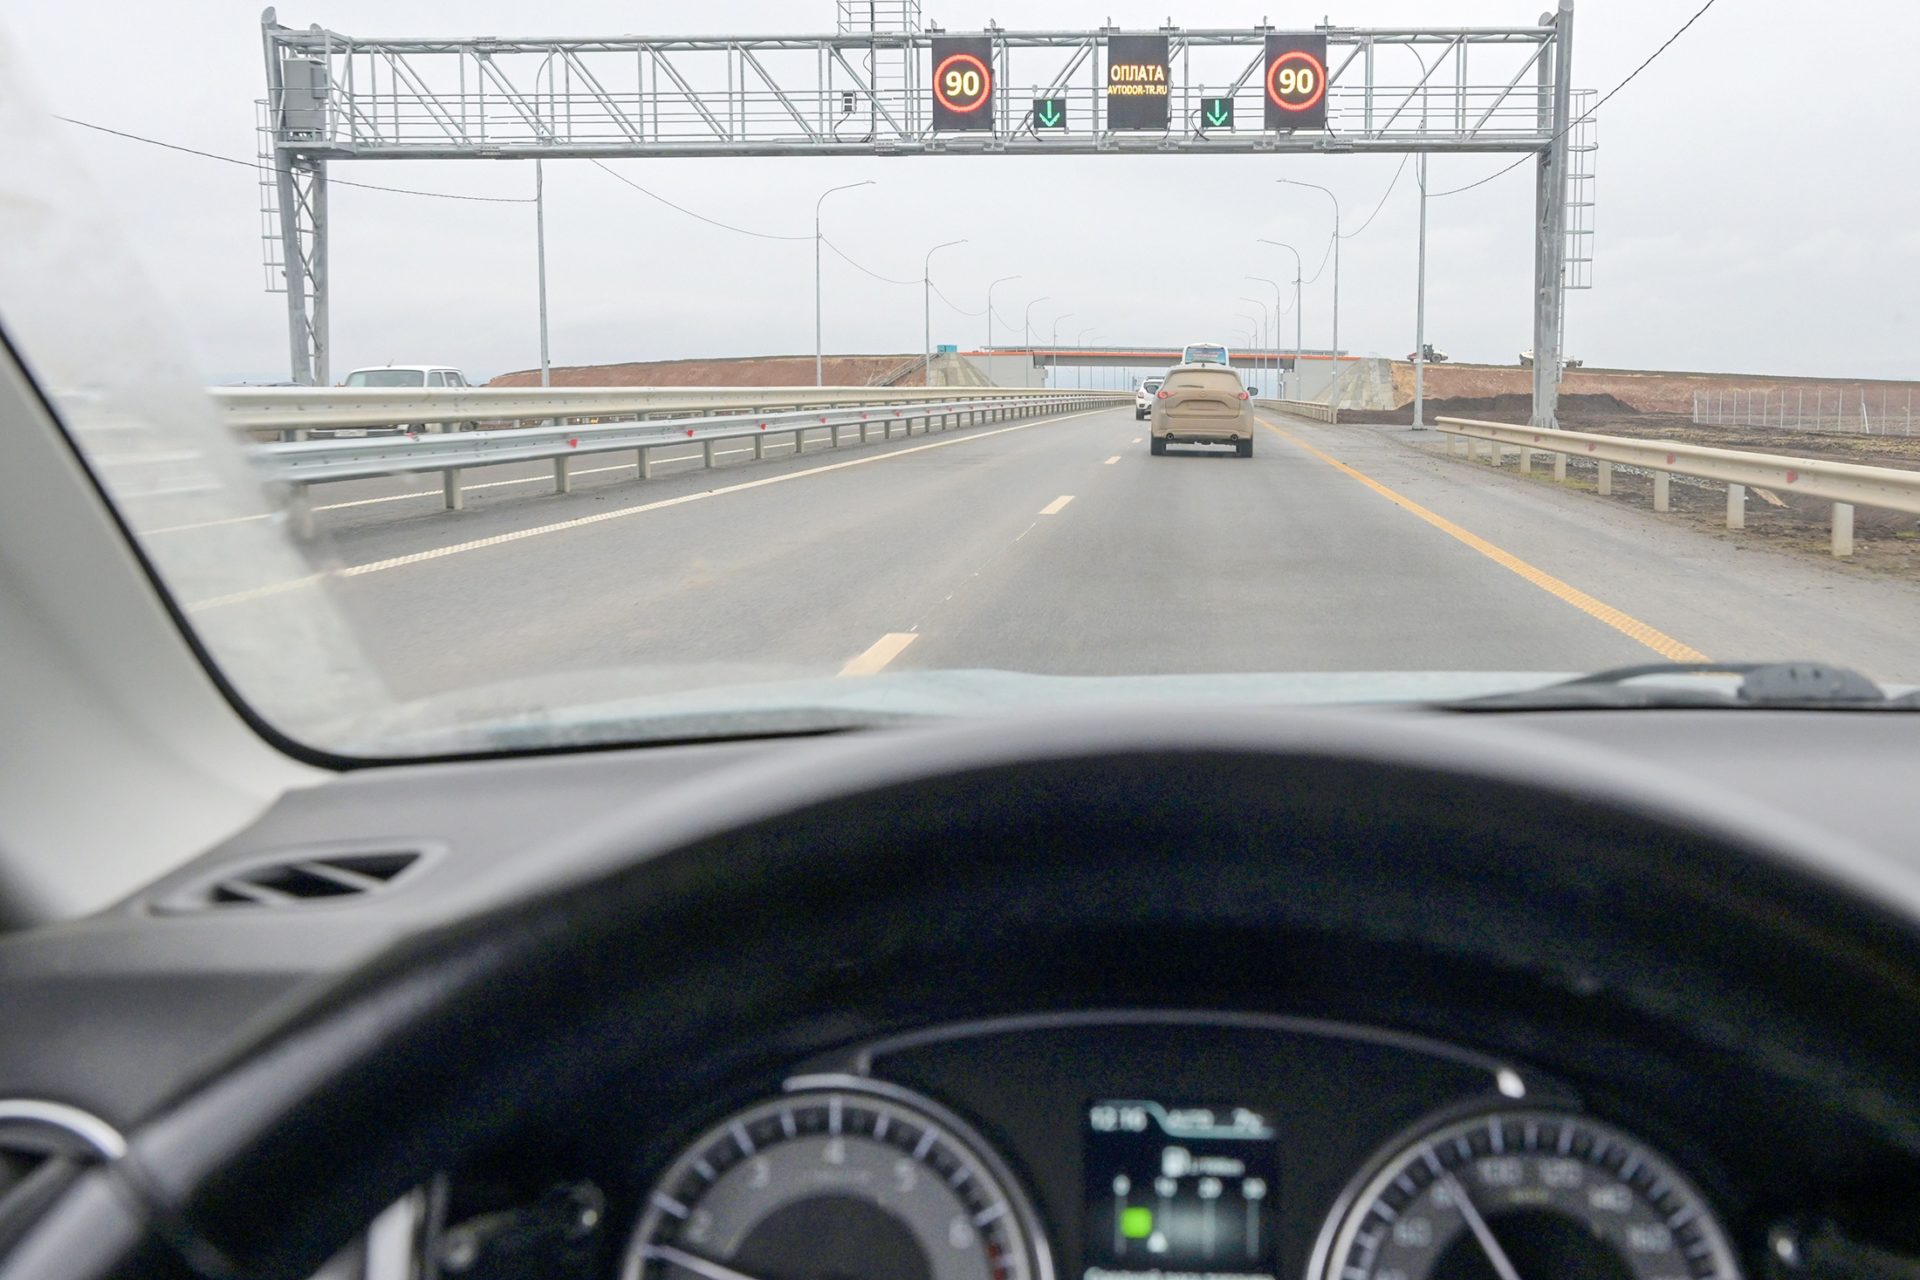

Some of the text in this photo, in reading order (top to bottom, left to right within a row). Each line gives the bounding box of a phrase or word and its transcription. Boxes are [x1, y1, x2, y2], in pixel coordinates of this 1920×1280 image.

[1111, 64, 1164, 81] ОПЛАТА
[1280, 68, 1313, 94] 90
[946, 71, 979, 96] 90
[1107, 85, 1167, 95] AVTODOR-TR.RU
